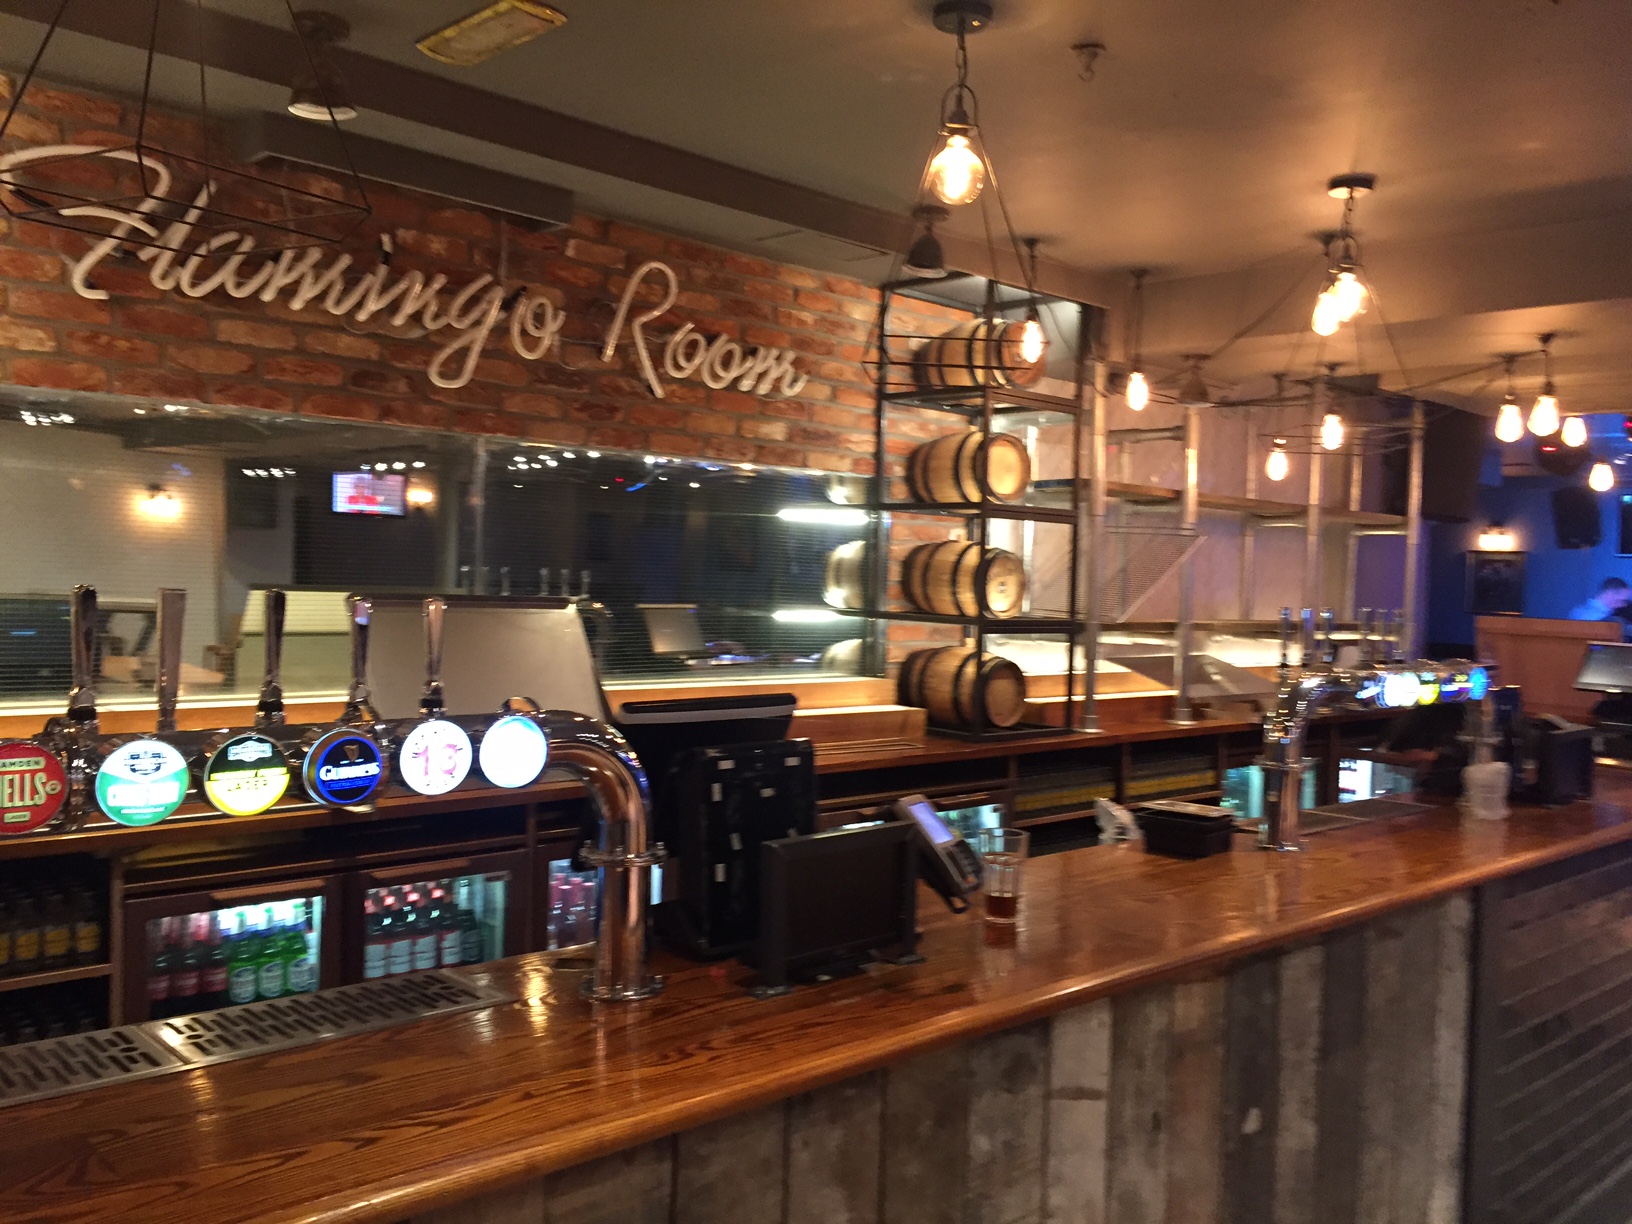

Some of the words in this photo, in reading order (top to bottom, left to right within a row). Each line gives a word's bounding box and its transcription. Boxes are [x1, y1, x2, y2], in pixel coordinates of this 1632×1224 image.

[0, 144, 566, 389] Flamingo
[601, 261, 809, 398] Room
[0, 758, 41, 768] AMDEN
[0, 771, 47, 808] ELLS
